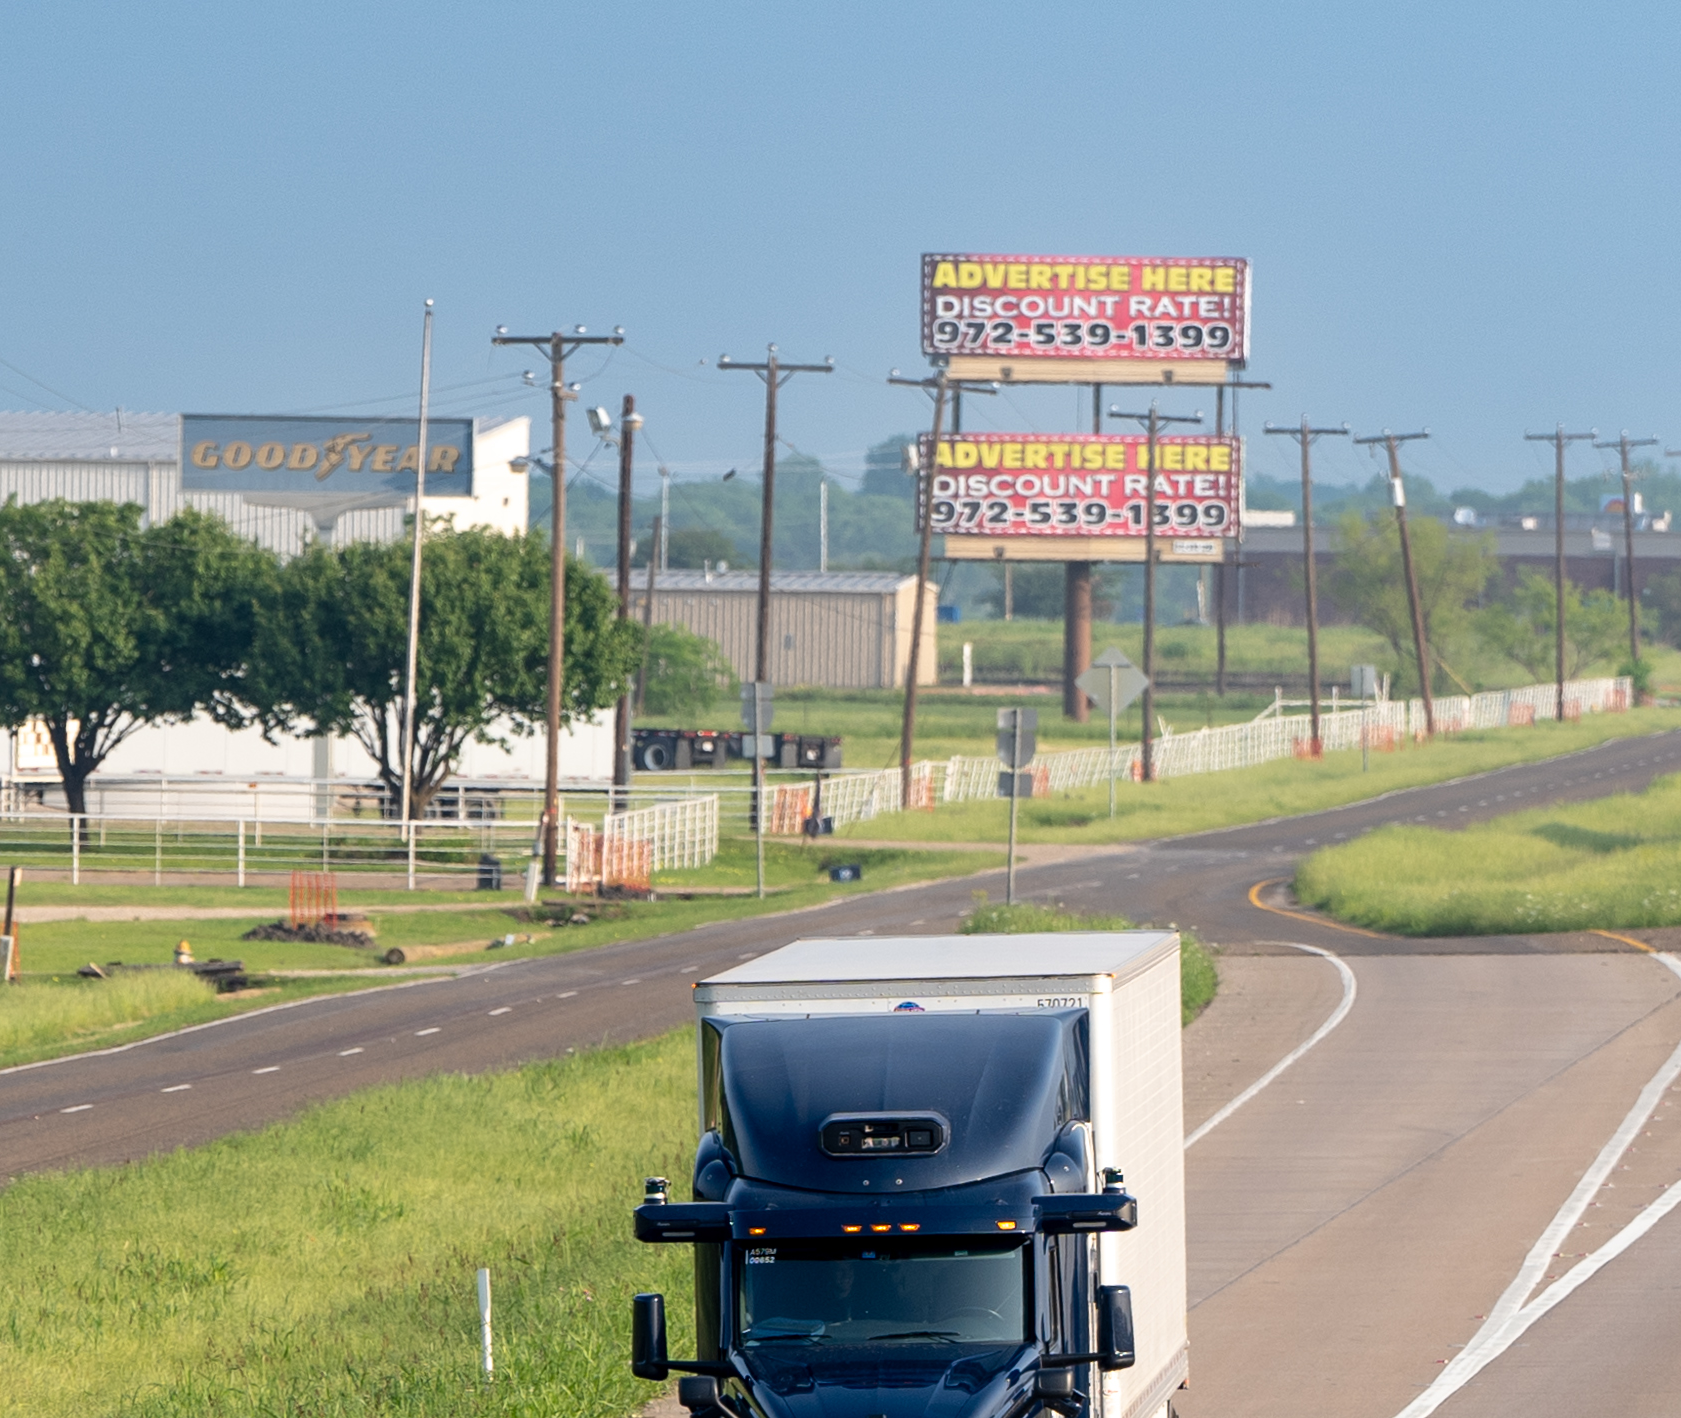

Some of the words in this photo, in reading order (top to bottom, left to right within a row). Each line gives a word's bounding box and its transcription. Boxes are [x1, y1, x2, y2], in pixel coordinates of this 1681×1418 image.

[932, 261, 1131, 291] ADVERTISE
[1141, 265, 1235, 293] HERE
[935, 294, 1120, 318] DISCOUNT
[1128, 295, 1231, 319] RATE!
[934, 319, 1233, 349] 972-539-1399
[191, 439, 461, 474] GOODYEAR
[936, 441, 1126, 470] ADVERTISE
[1136, 444, 1231, 472] HERE
[933, 474, 1117, 497] DISCOUNT
[1124, 474, 1227, 498] RATE!
[931, 499, 1228, 528] 972-539-1399
